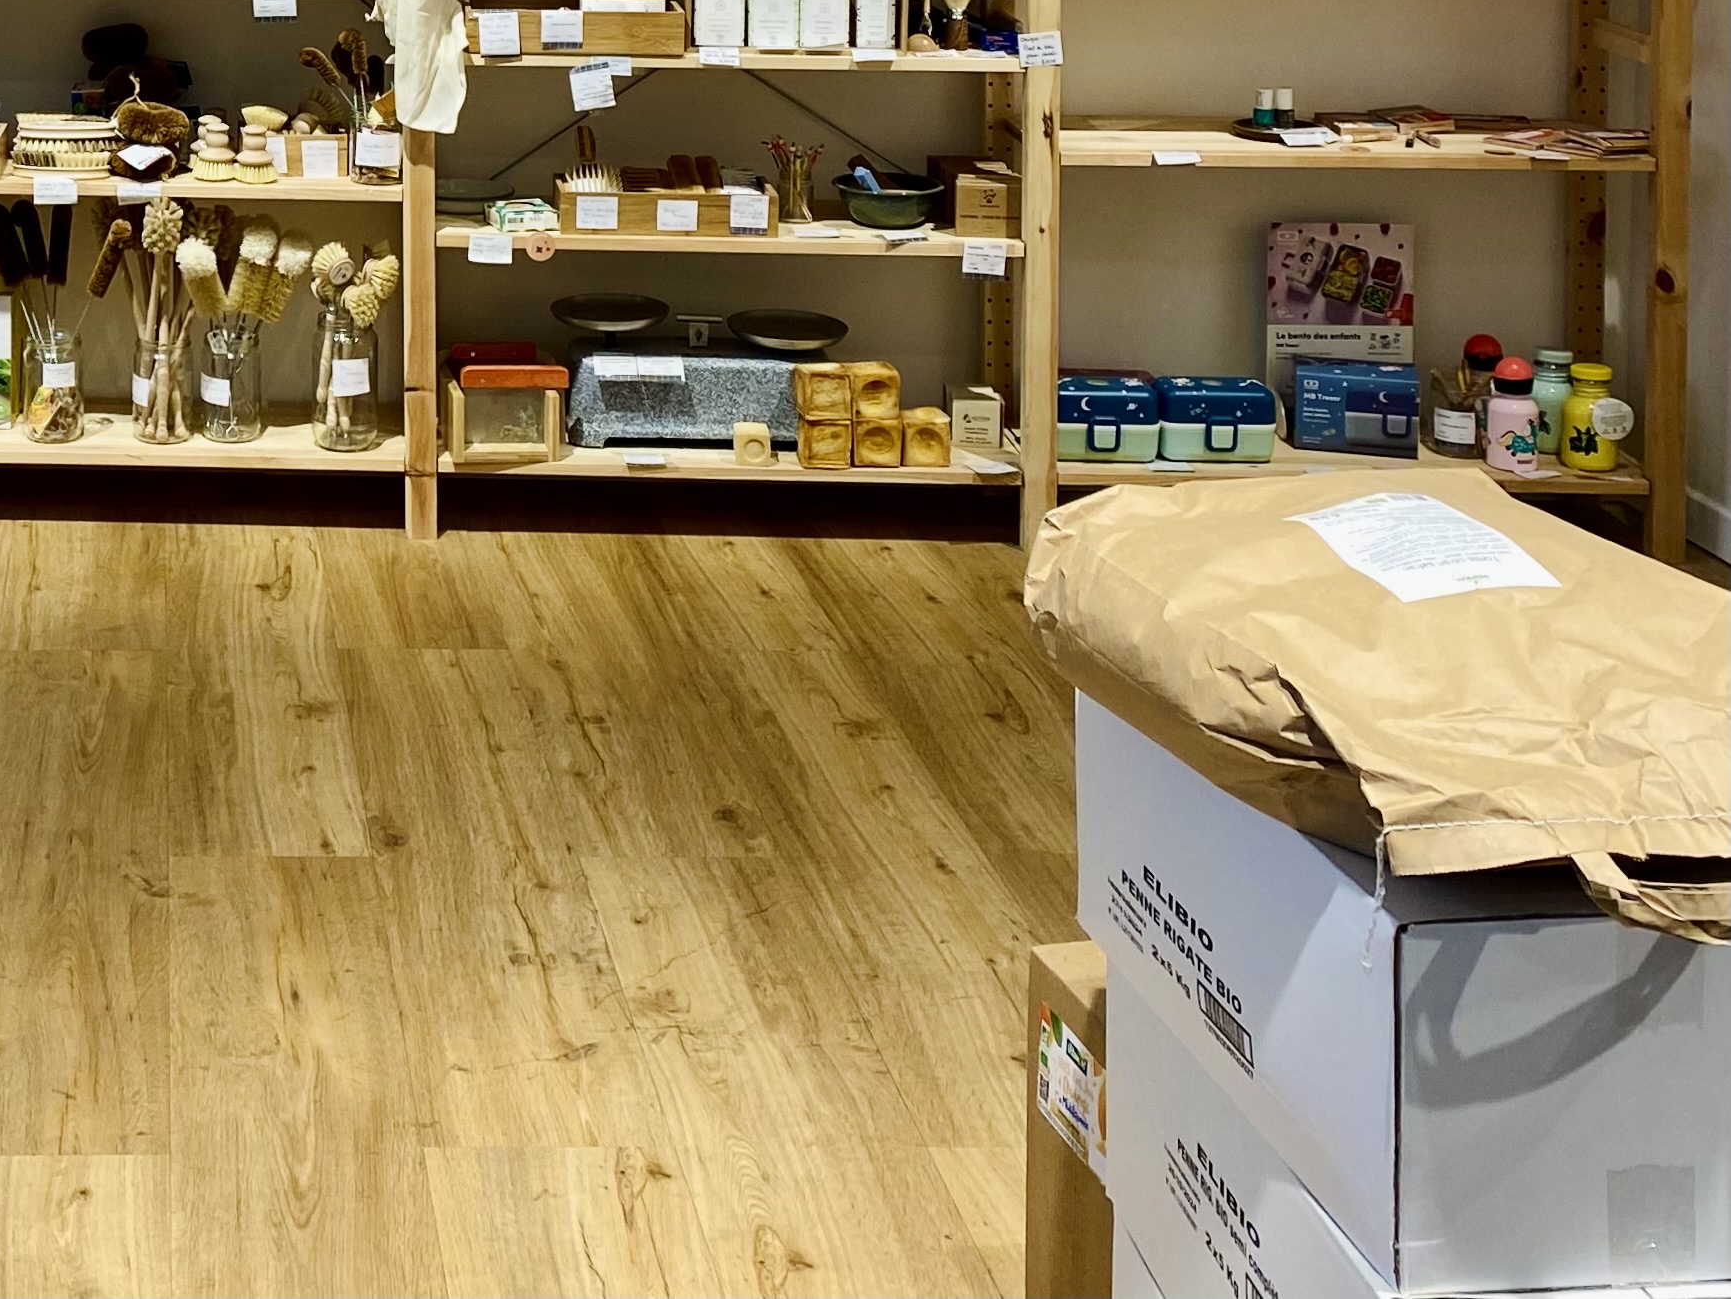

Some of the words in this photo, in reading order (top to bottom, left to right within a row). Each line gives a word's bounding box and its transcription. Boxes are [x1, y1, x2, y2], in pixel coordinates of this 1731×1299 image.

[1288, 332, 1311, 340] bento
[1313, 332, 1328, 340] des
[1330, 332, 1361, 340] enfants
[1121, 869, 1161, 926] PENNE
[1164, 919, 1213, 985] RIGATE
[1216, 976, 1242, 1015] BIO
[1143, 865, 1213, 952] ELIBIO
[1151, 944, 1173, 977] 2x5
[1197, 1142, 1260, 1249] ELIBIO
